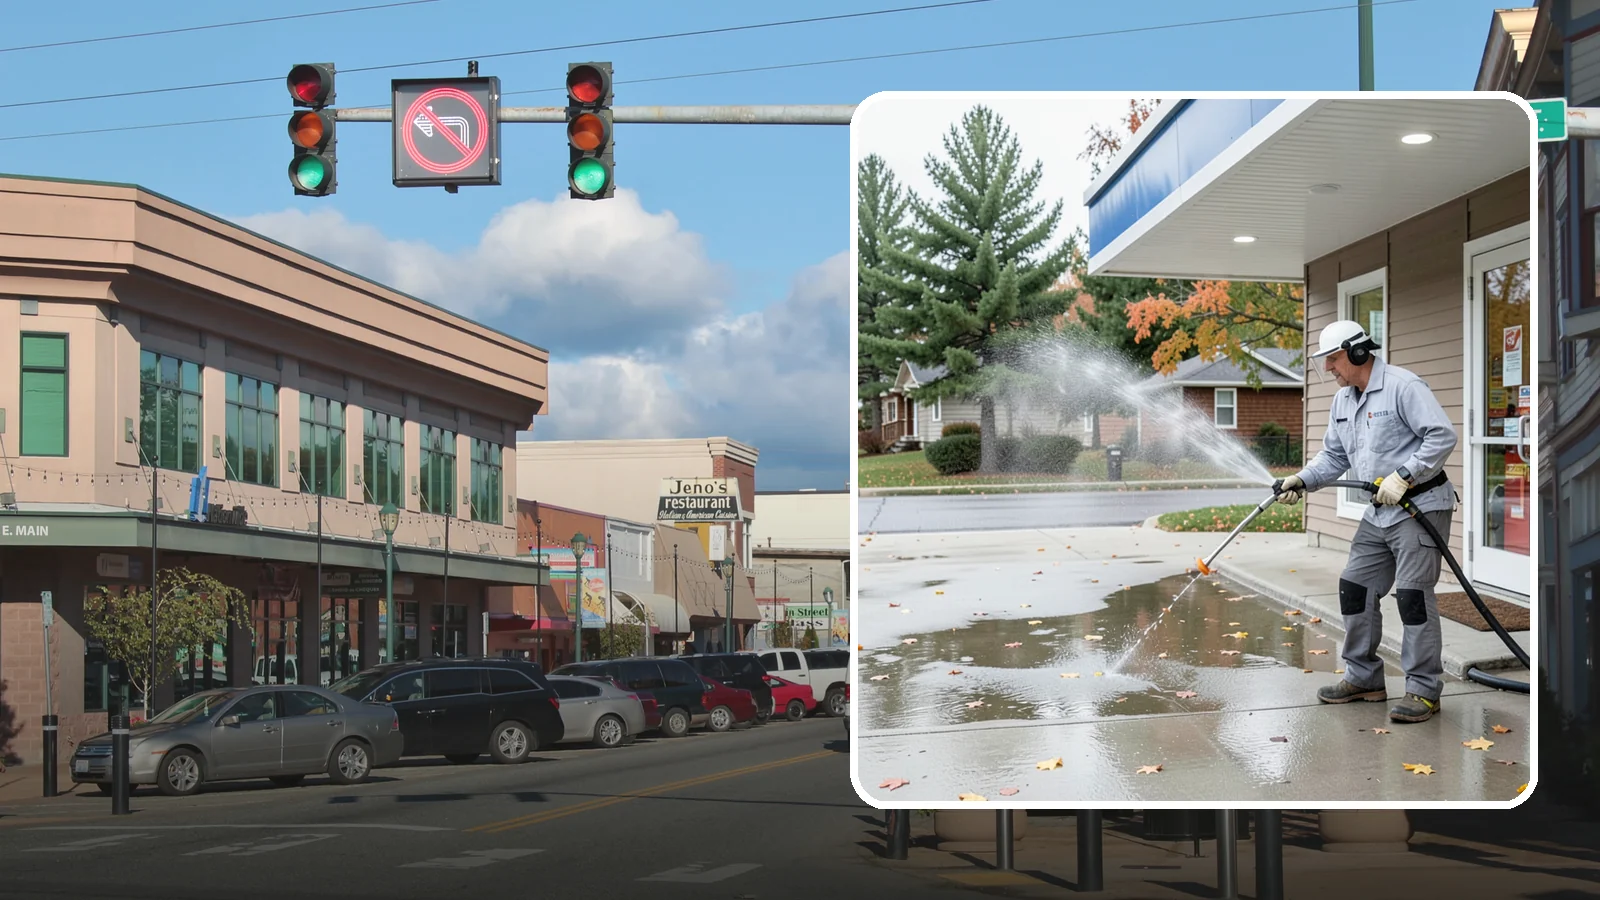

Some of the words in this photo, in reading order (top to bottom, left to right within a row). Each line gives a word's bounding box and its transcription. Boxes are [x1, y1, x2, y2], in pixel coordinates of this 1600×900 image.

[670, 480, 727, 494] Jeno's
[665, 496, 731, 509] restaurant
[659, 510, 681, 519] Italian
[686, 510, 714, 519] American
[715, 509, 738, 519] Cuisine
[2, 525, 13, 536] E.
[15, 525, 49, 536] MAIN
[797, 607, 828, 617] Street
